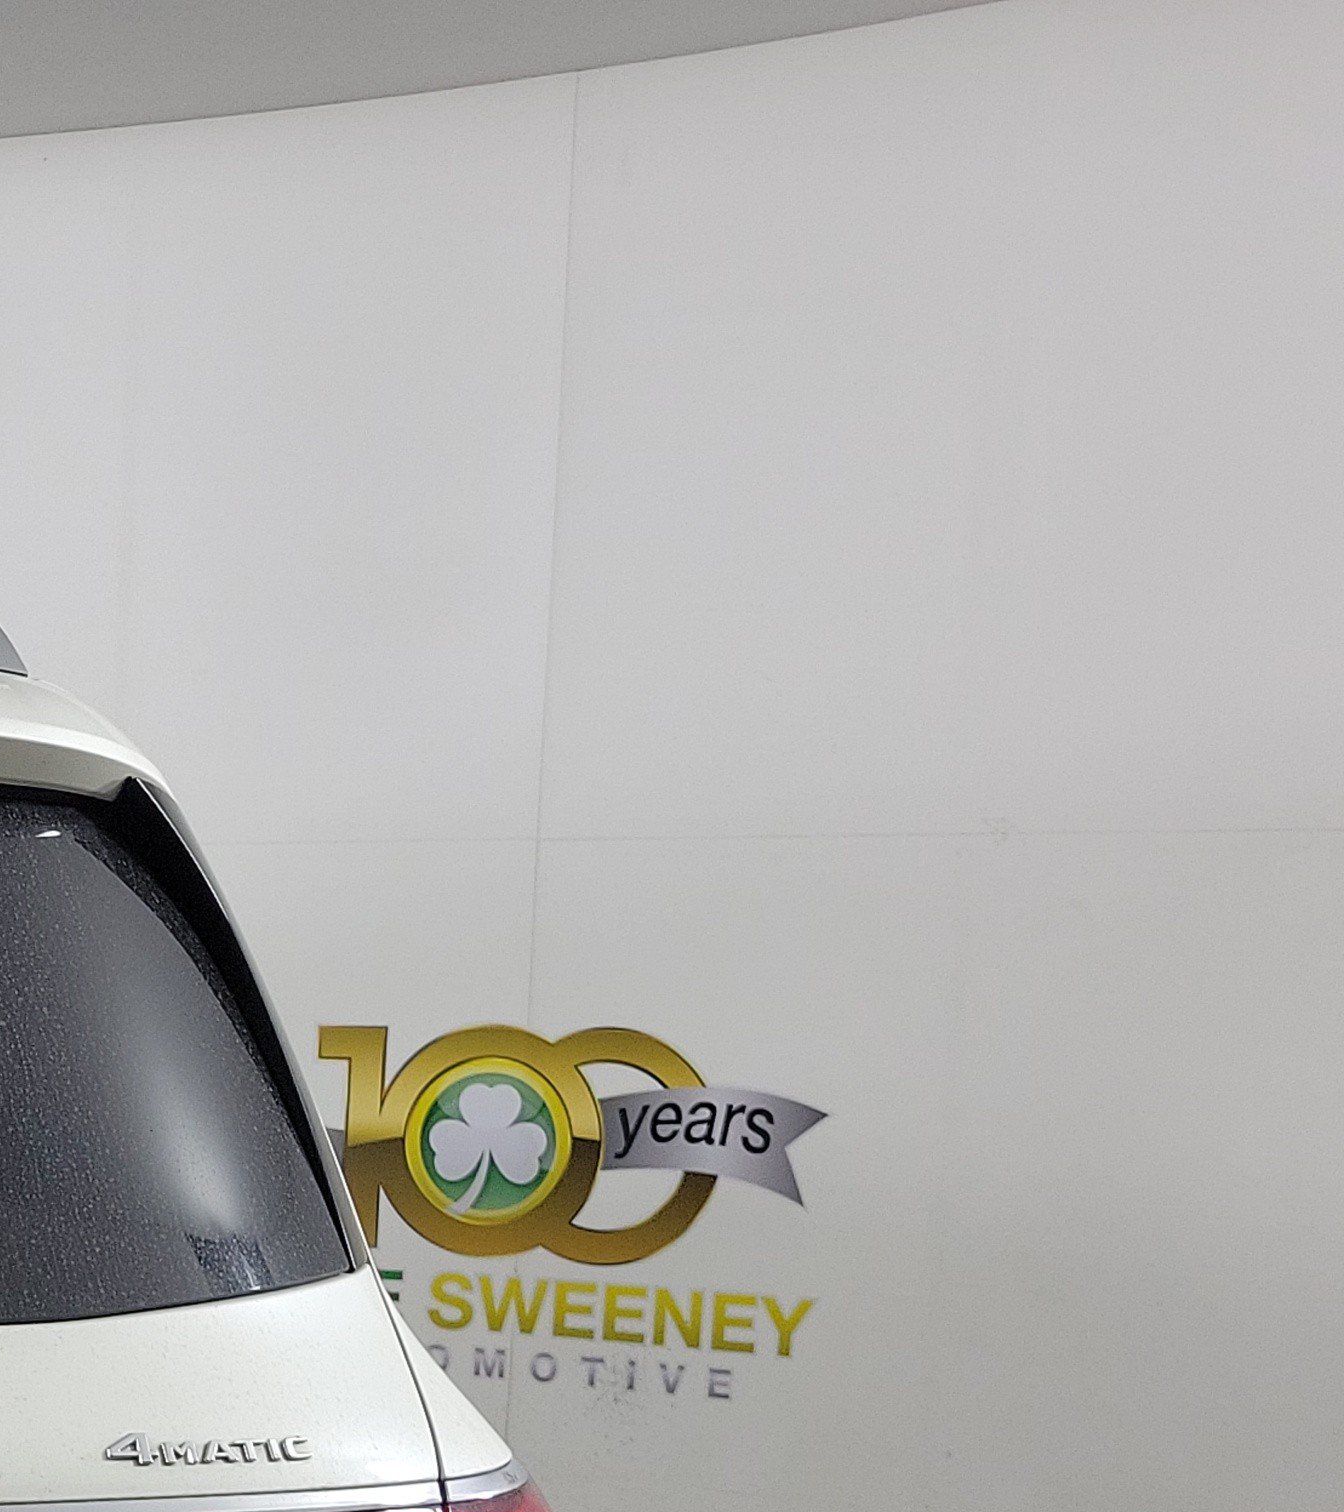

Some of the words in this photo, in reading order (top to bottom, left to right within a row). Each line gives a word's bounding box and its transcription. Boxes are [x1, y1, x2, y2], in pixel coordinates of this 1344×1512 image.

[318, 1025, 717, 1265] 100
[613, 1100, 776, 1159] years
[427, 1271, 814, 1357] SWEENEY
[104, 1432, 313, 1467] 4MATIC
